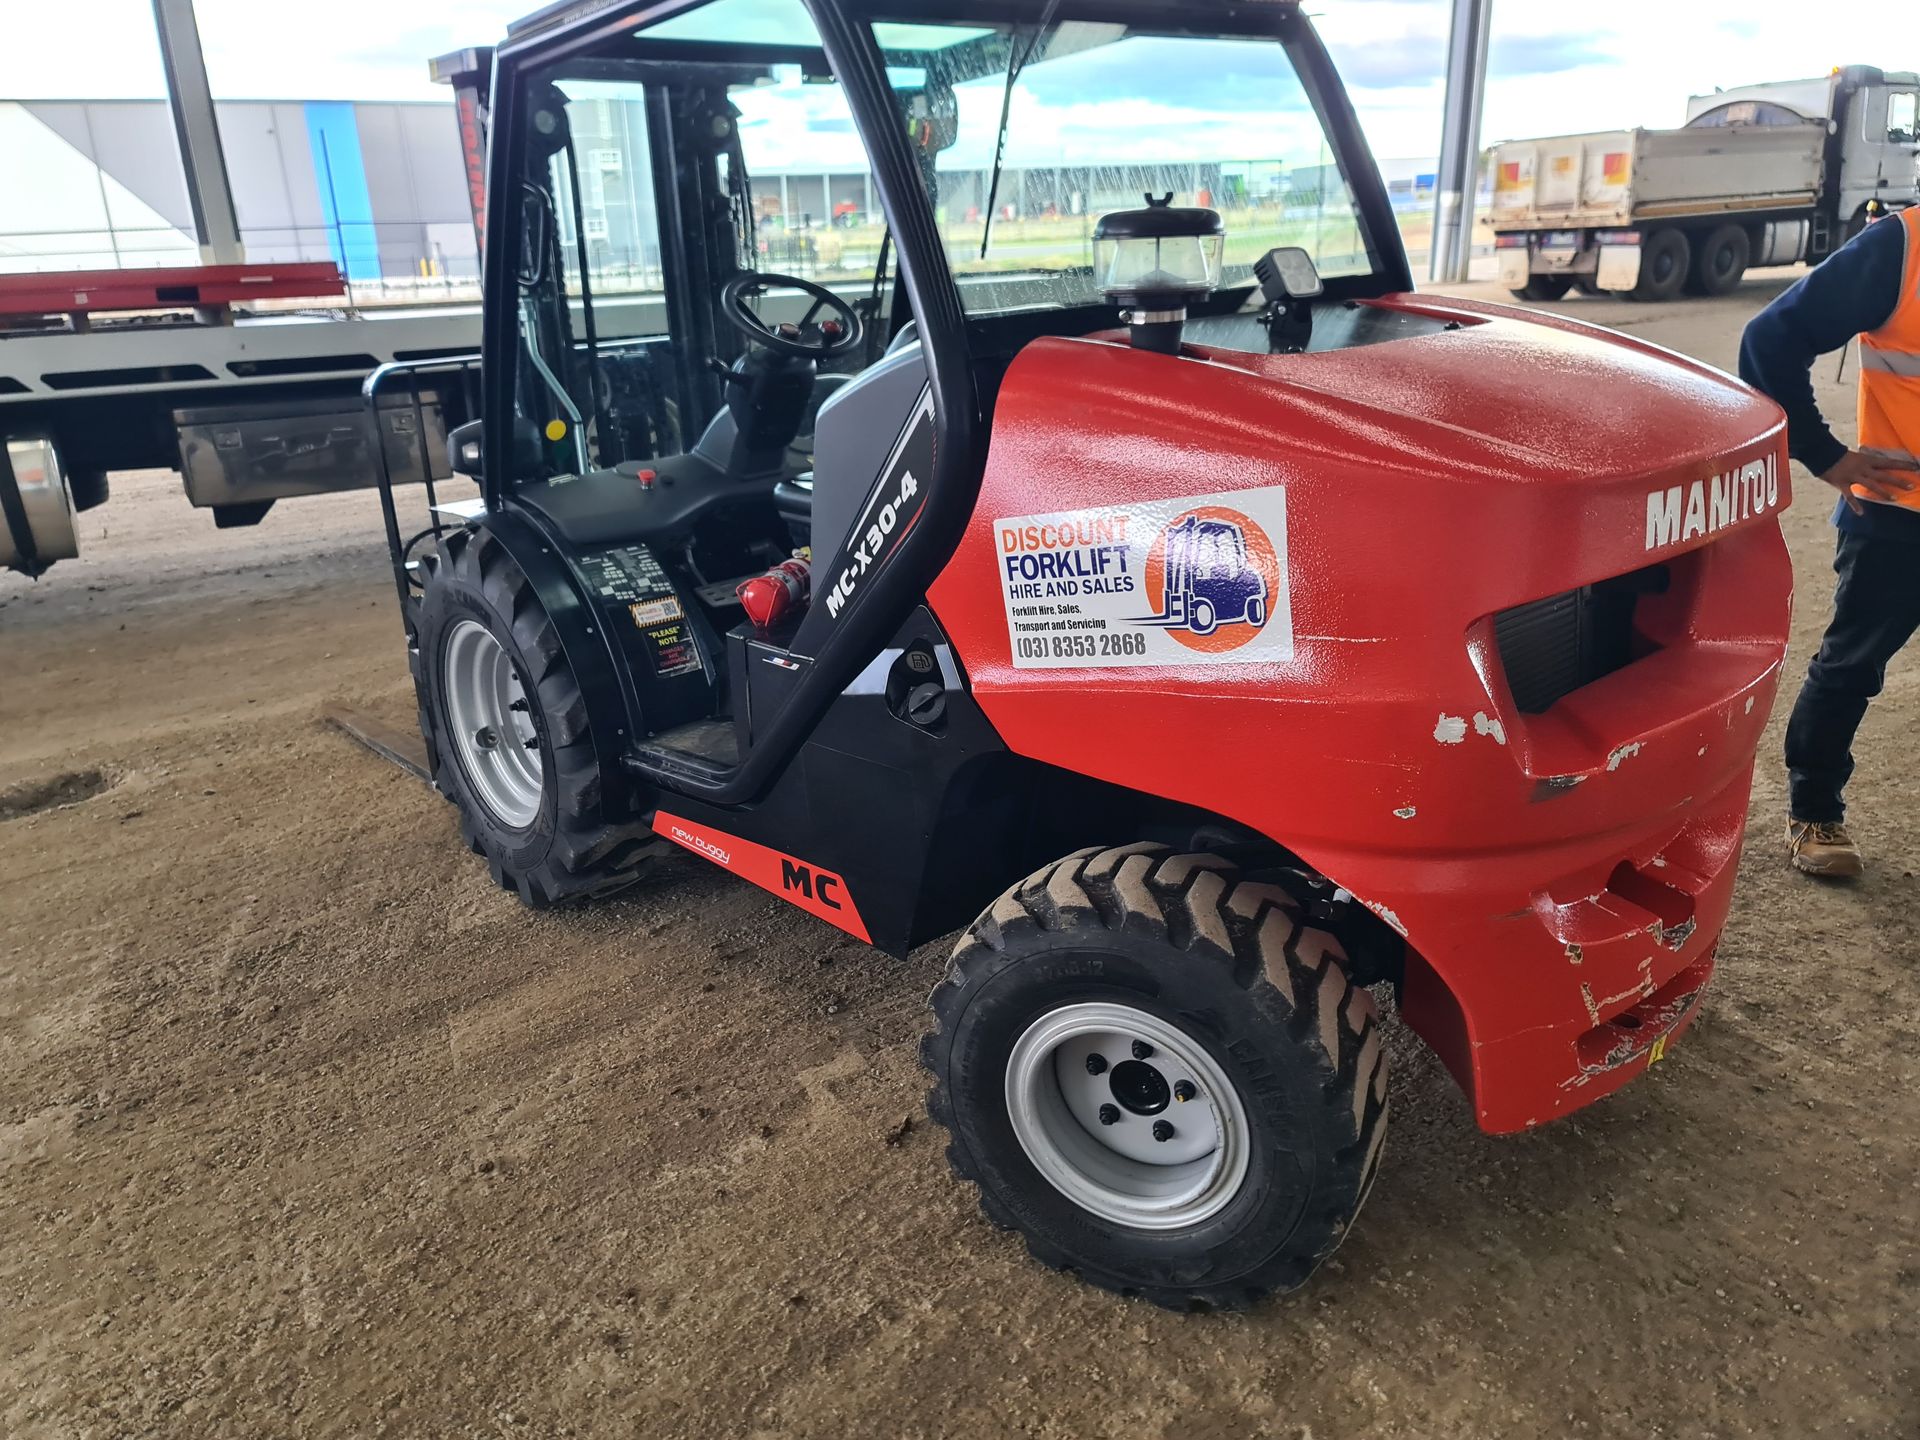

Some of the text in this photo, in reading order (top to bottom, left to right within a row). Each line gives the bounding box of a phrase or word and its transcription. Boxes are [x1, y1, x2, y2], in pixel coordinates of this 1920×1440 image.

[1645, 450, 1777, 551] MANITOU
[825, 470, 918, 619] MC-X30-4
[1002, 515, 1130, 553] DISCOUNT
[1006, 545, 1131, 582] FORKLIFT
[1010, 576, 1134, 599] HIRE AND SALES
[1012, 603, 1082, 617] Forklift Hire, Sales,
[1014, 617, 1107, 633] Transport and Servicing
[658, 635, 679, 647] NOTE
[1017, 632, 1147, 659] (03) 8353 2868
[671, 826, 730, 864] new buggy
[781, 858, 842, 911] MC
